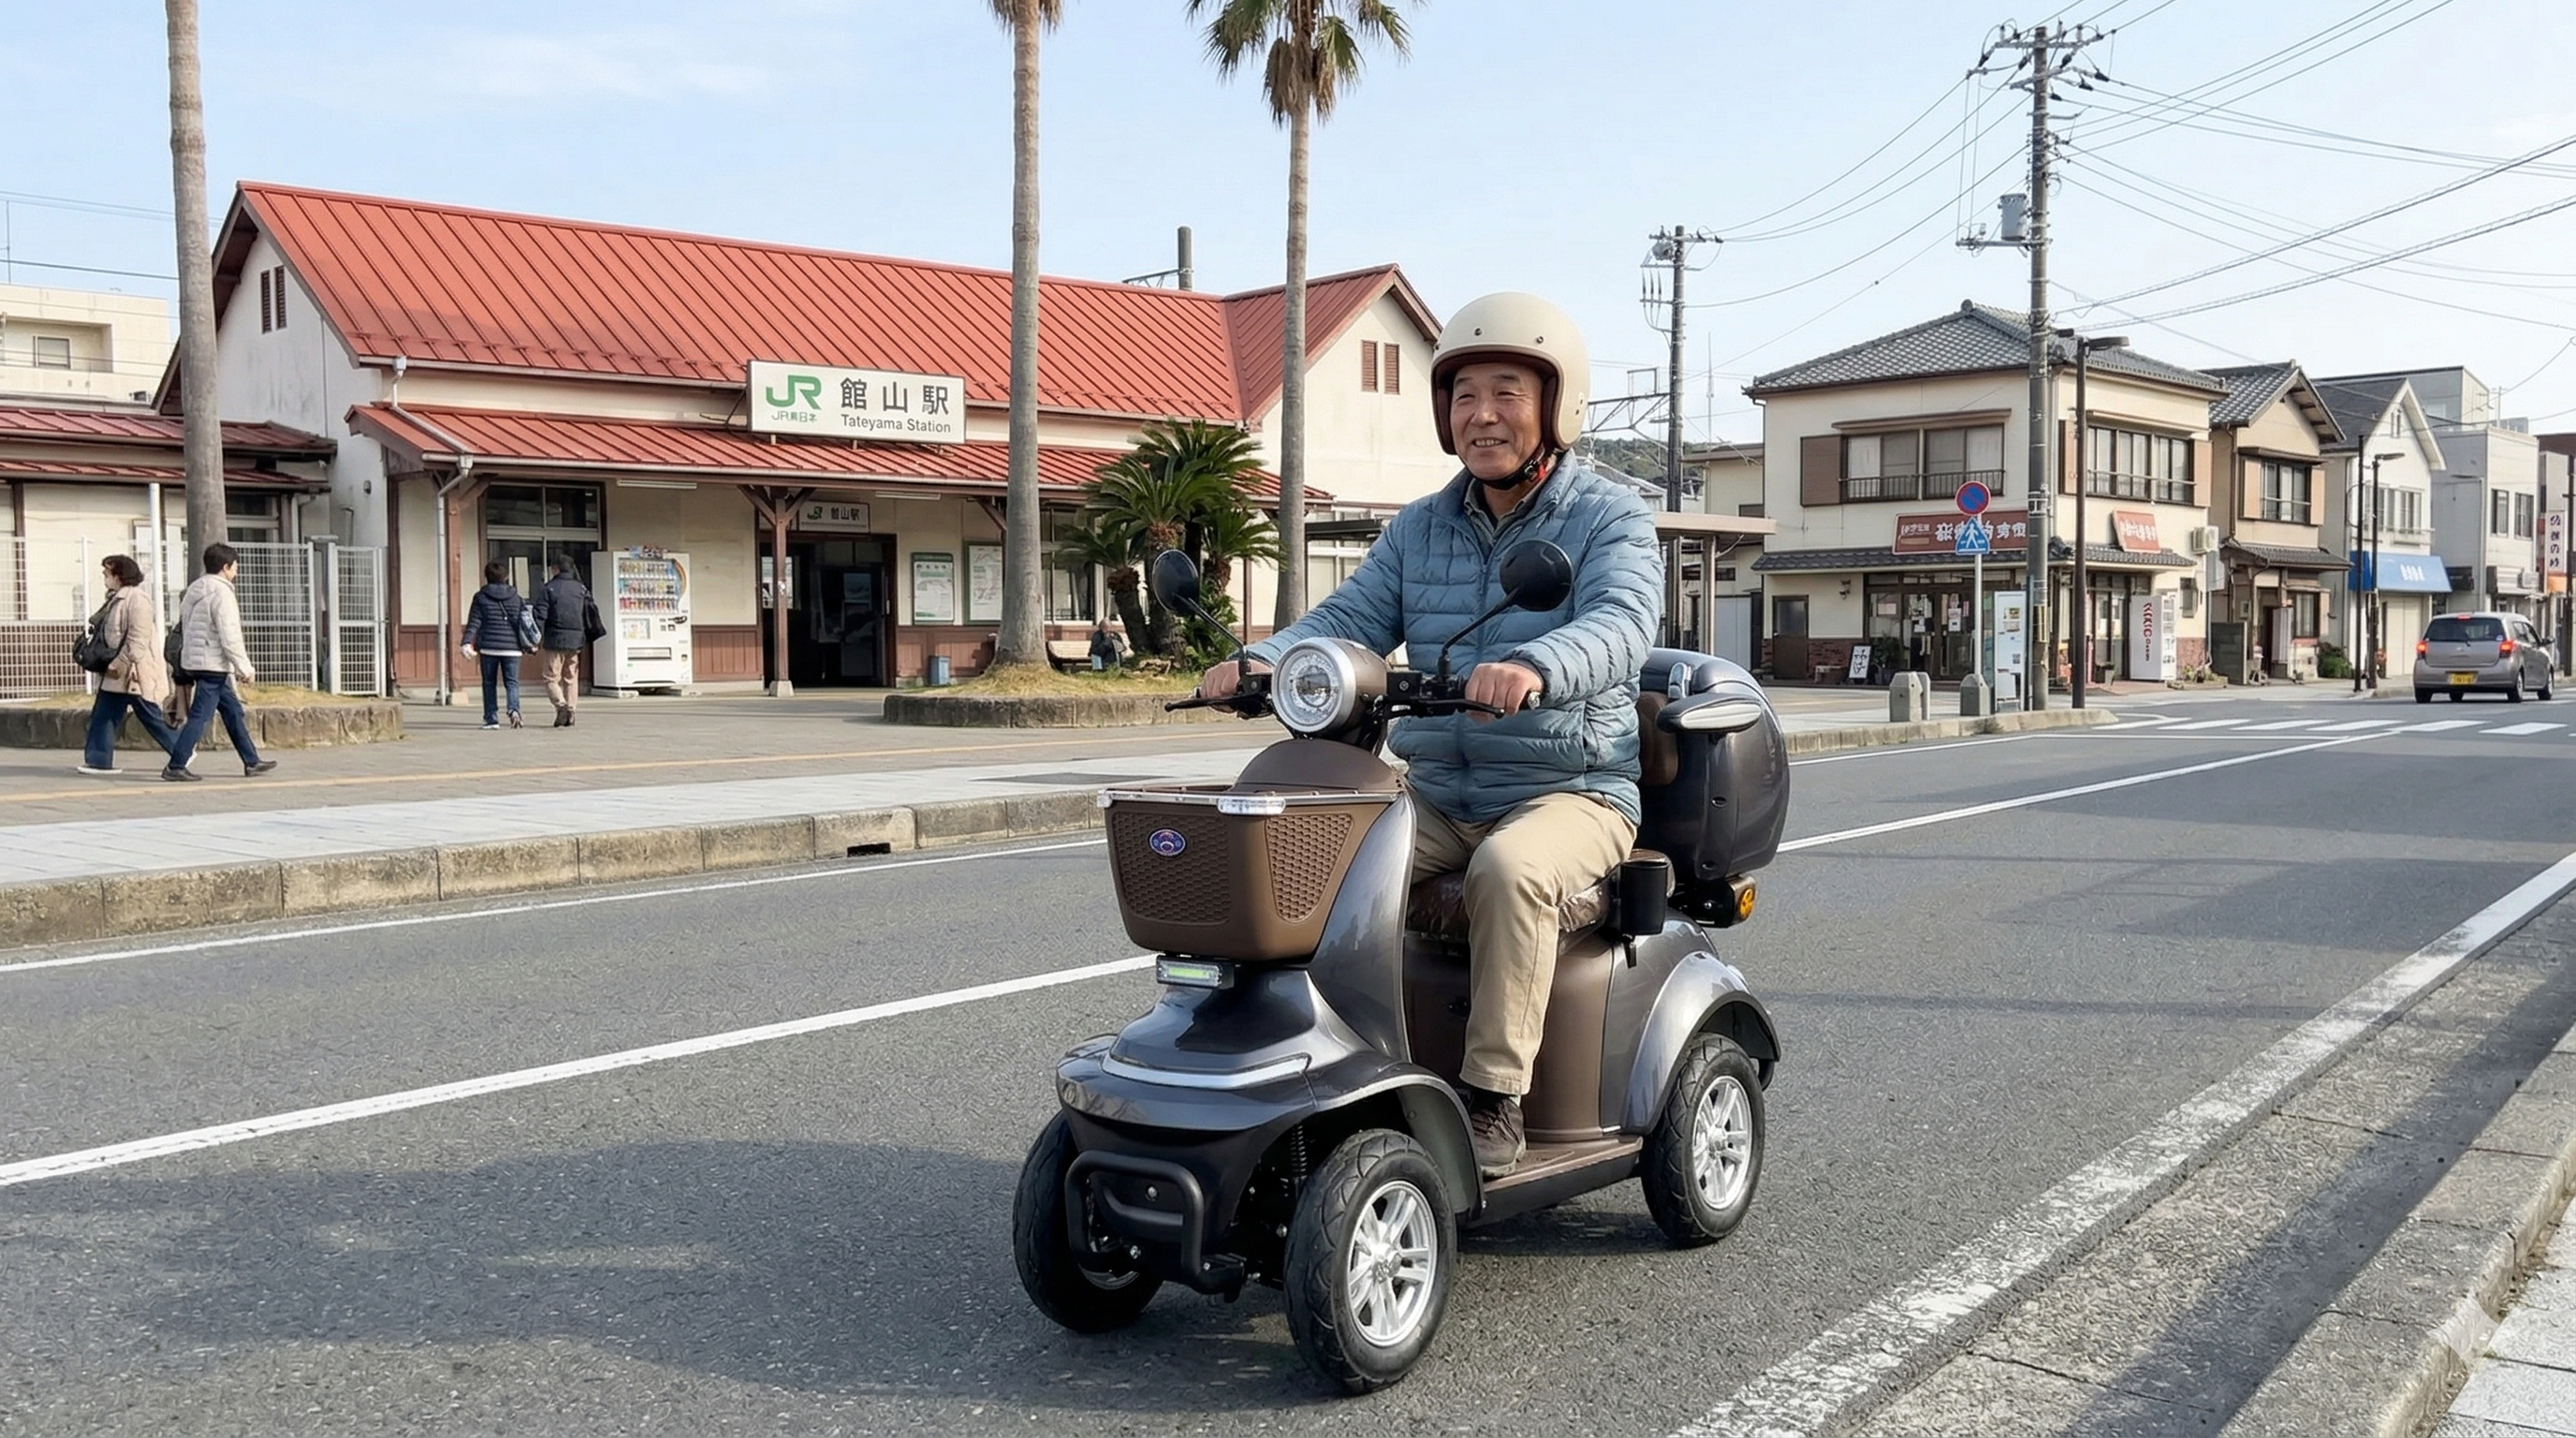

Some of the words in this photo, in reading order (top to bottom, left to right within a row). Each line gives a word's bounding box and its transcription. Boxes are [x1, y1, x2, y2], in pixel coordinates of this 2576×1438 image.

[766, 374, 822, 410] JR
[840, 376, 949, 416] 館山駅
[841, 413, 903, 432] Tateyama
[906, 418, 951, 433] Station
